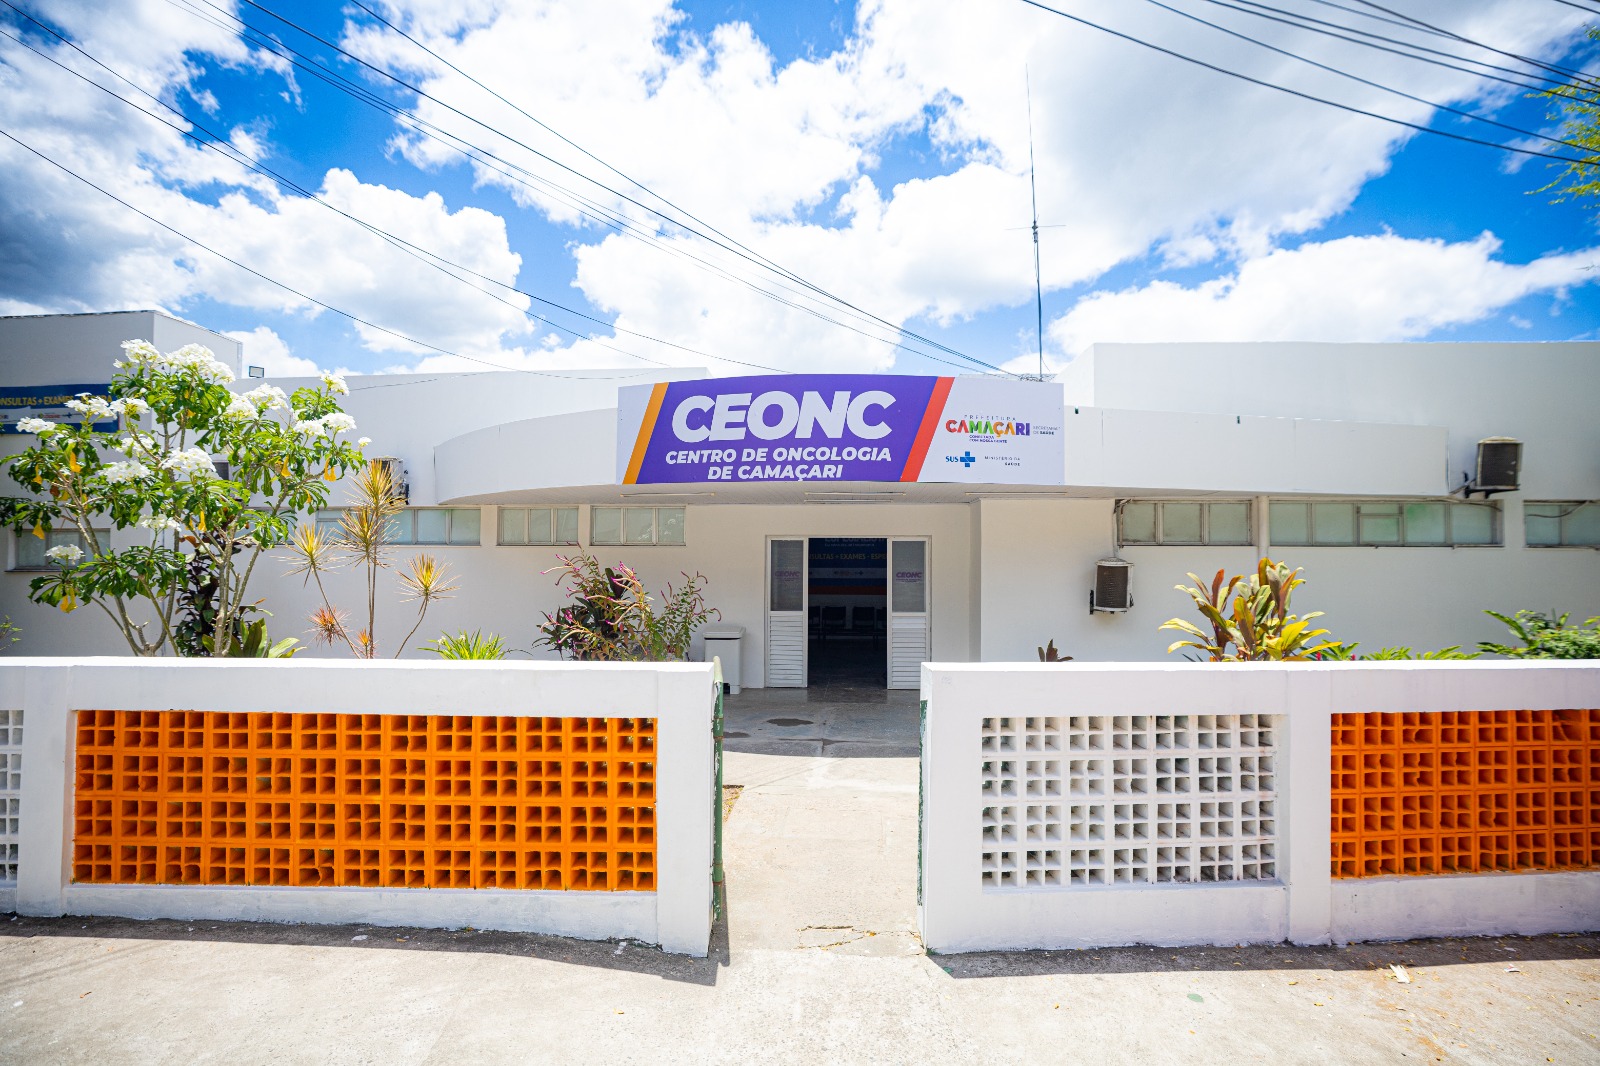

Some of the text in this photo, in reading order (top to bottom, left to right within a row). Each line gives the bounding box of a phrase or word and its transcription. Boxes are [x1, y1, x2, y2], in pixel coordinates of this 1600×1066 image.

[671, 390, 897, 443] CEONC
[945, 419, 1031, 438] CAMAÇARI
[665, 446, 892, 464] CENTRO DE ONCOLOGIA
[945, 455, 959, 463] SUS
[707, 464, 843, 482] DE CAMAÇARI
[895, 571, 922, 579] CEONC
